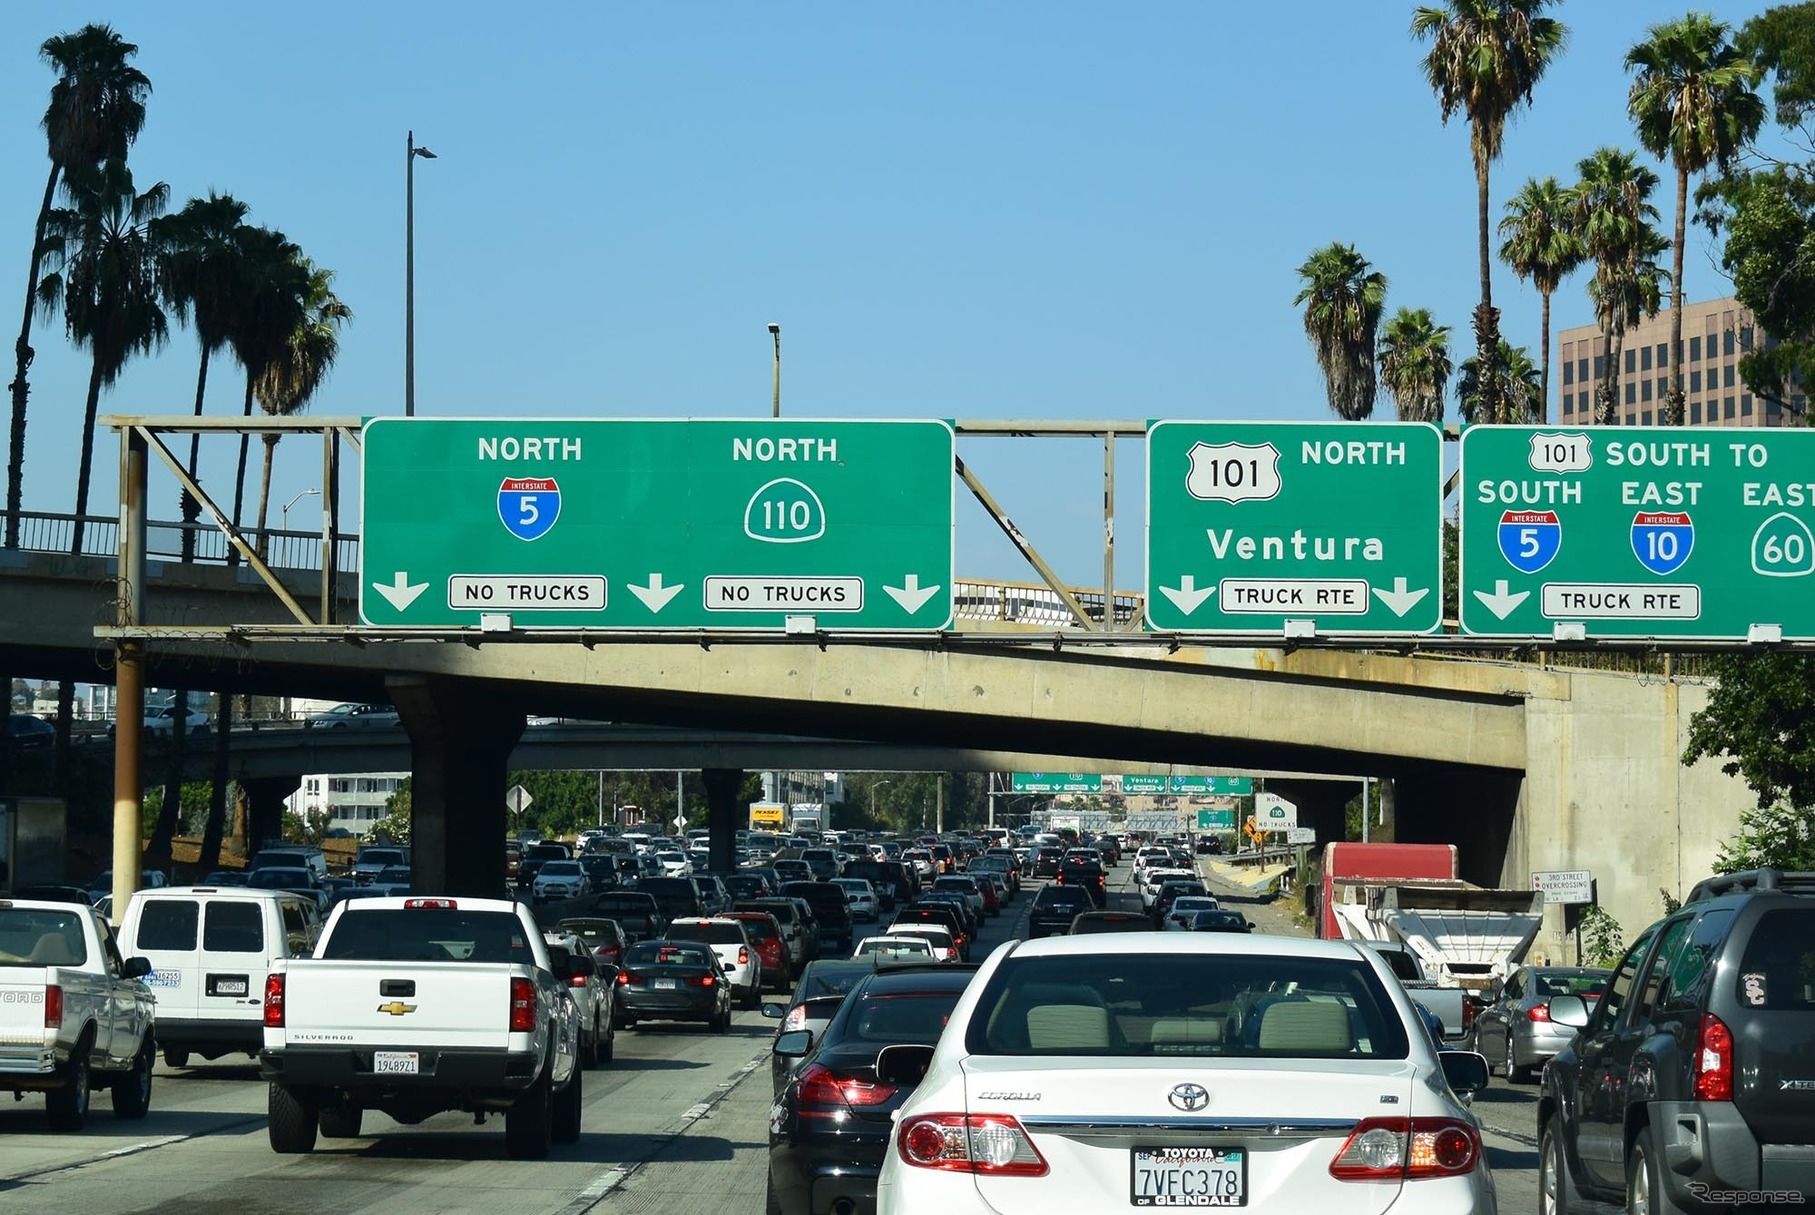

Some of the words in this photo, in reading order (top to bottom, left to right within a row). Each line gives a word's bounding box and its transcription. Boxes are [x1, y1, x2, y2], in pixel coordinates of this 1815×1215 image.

[478, 436, 582, 461] NORTH
[733, 437, 837, 462] NORTH
[1301, 441, 1406, 465] NORTH
[1544, 444, 1575, 463] 101
[1606, 441, 1710, 467] SOUTH
[1729, 443, 1768, 468] TO
[1210, 459, 1257, 488] 101
[511, 482, 548, 491] INTERSTATE
[1478, 480, 1582, 504] SOUTH
[1622, 481, 1703, 506] EAST
[1743, 482, 1815, 507] EAST
[519, 496, 539, 525] 5
[763, 500, 810, 531] 110
[1511, 515, 1548, 524] INTERSTATE
[1644, 516, 1681, 525] INTERSTATE
[1206, 528, 1383, 561] Ventura
[1520, 528, 1540, 558] 5
[1647, 531, 1678, 561] 10
[1763, 534, 1804, 564] 60
[466, 584, 494, 600] NO
[506, 584, 590, 601] TRUCKS
[722, 585, 750, 602] NO
[763, 586, 846, 602] TRUCKS
[1234, 588, 1303, 604] TRUCK
[1316, 589, 1355, 605] RTE
[1560, 593, 1631, 609] TRUCK
[1643, 594, 1681, 610] RTE
[1272, 809, 1282, 817] 110
[1541, 880, 1587, 890] OVERCROSSING
[1562, 873, 1583, 881] STREET
[0, 991, 44, 1003] ORD
[377, 1060, 415, 1072] 19489Z1
[978, 1092, 1042, 1101] COROLLA
[1162, 1148, 1214, 1158] TOYOTA
[1139, 1169, 1238, 1195] 7VFC378
[1155, 1195, 1240, 1206] GLENDALE
